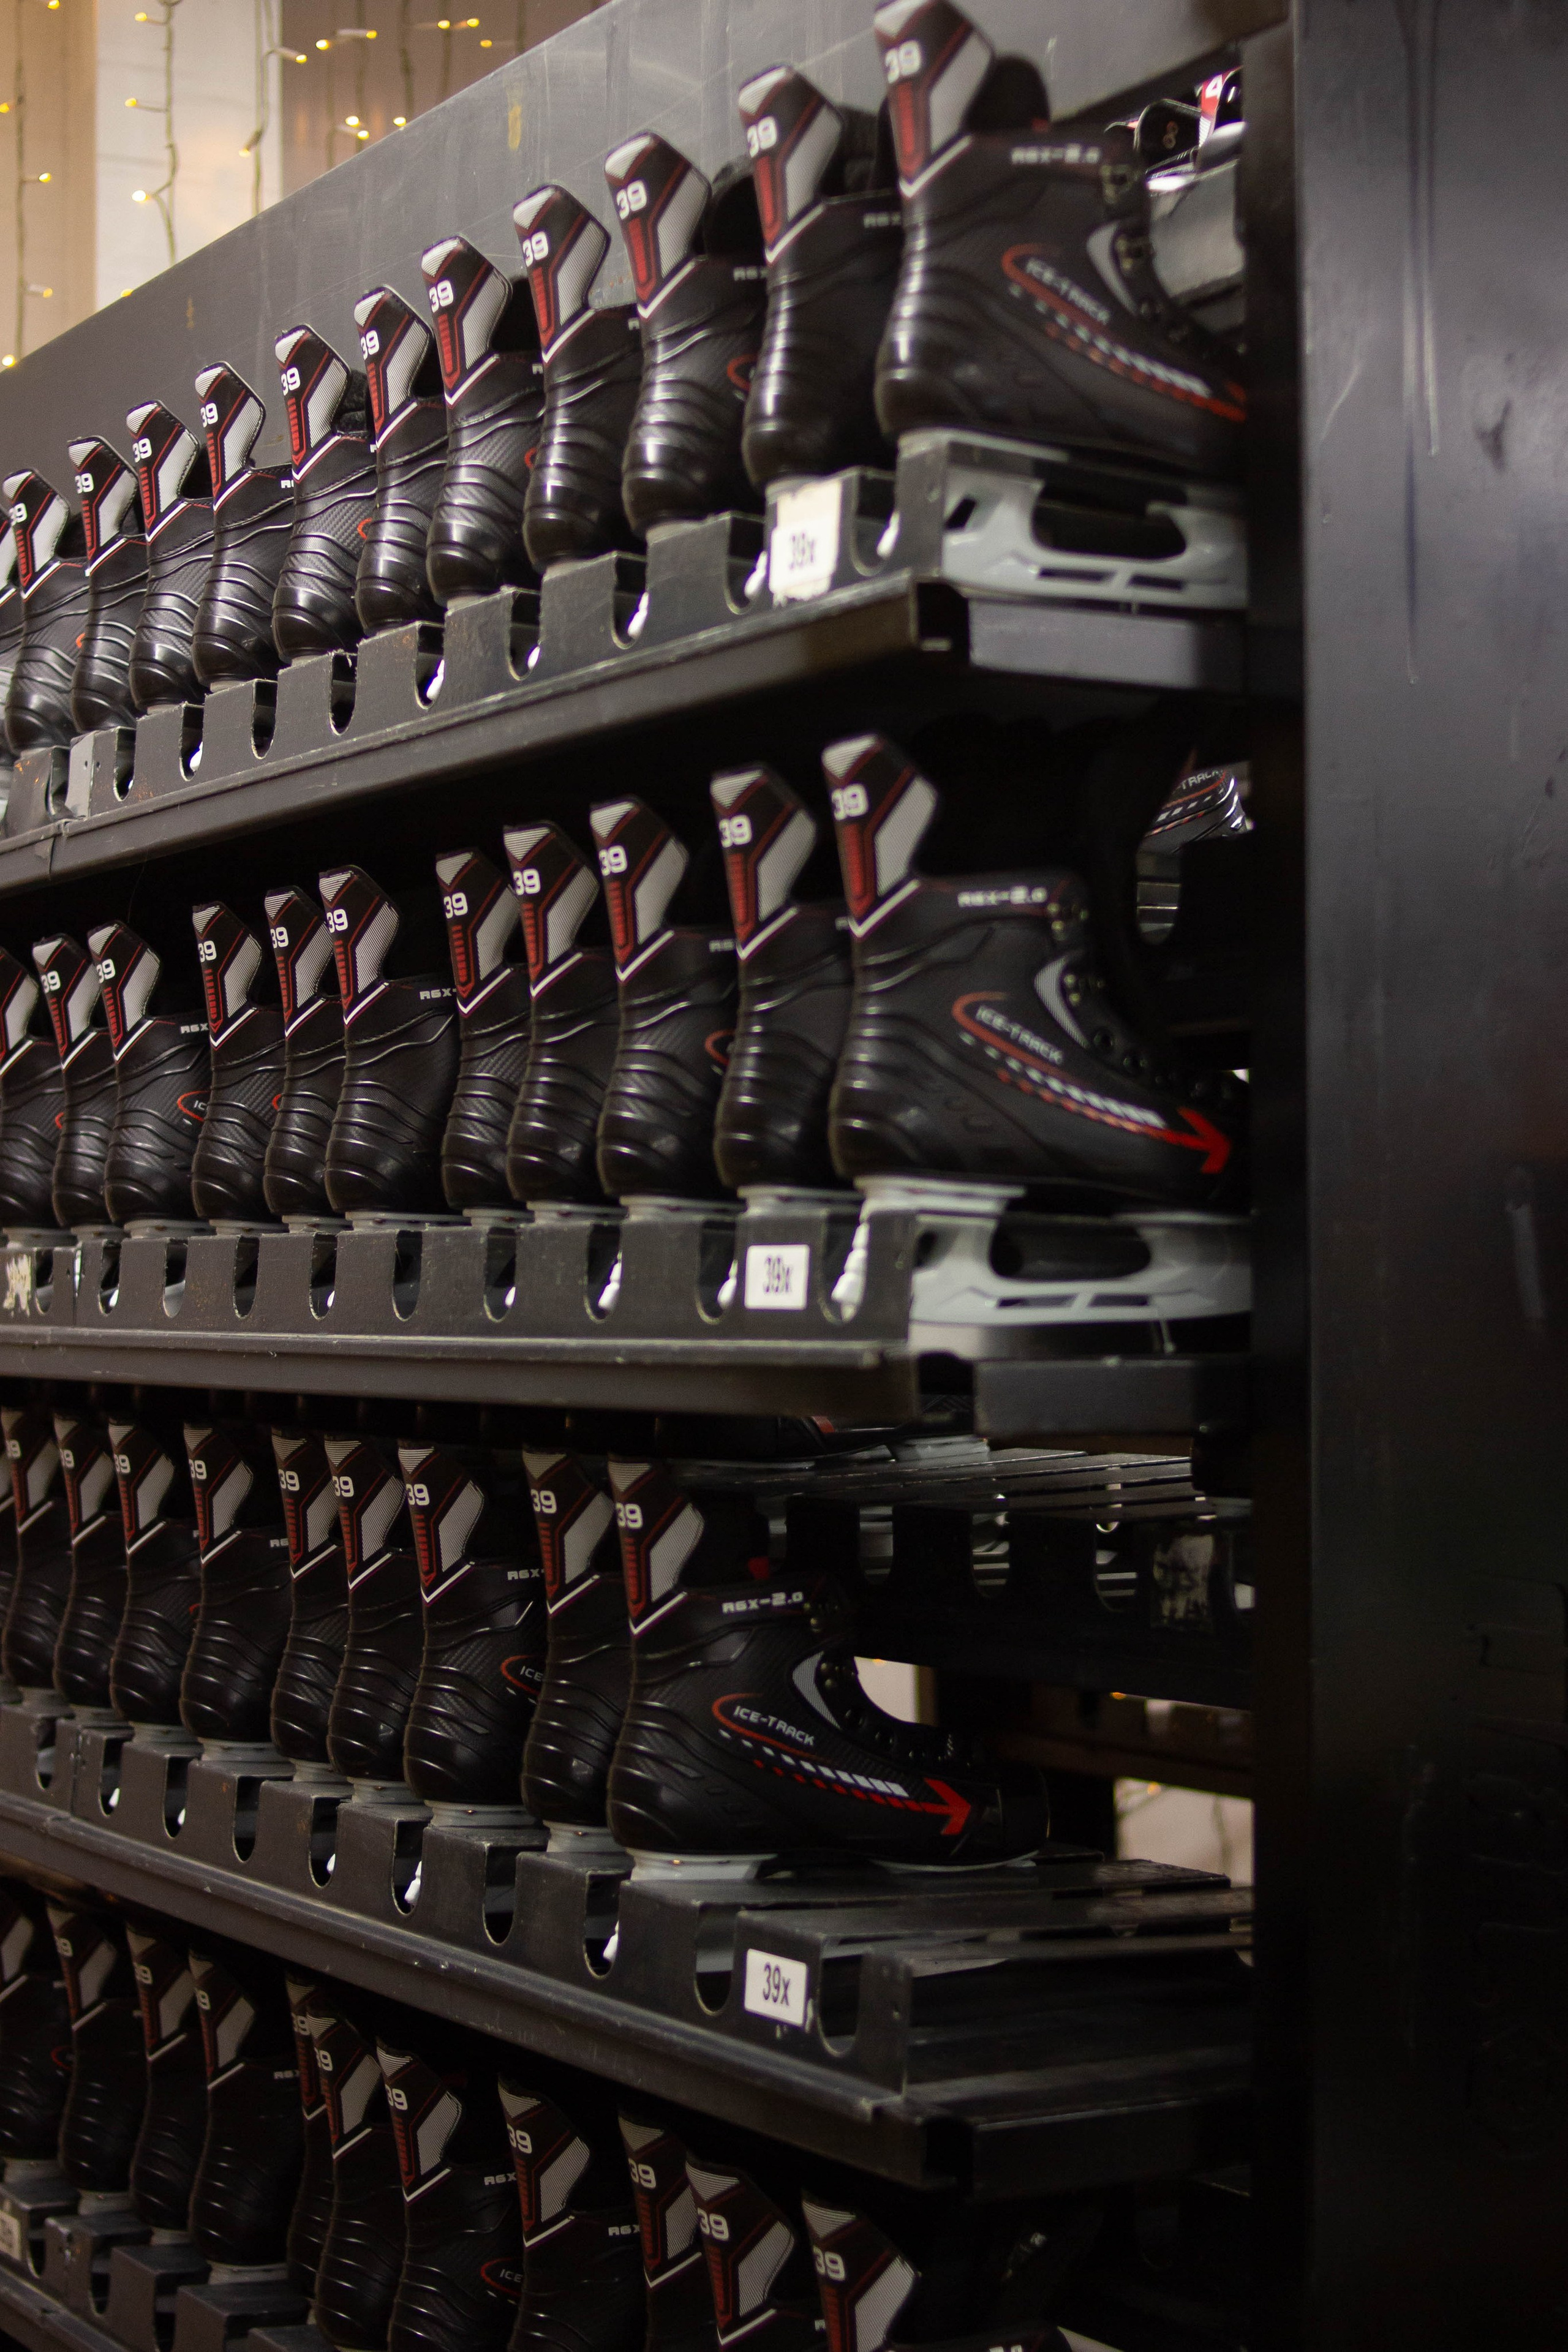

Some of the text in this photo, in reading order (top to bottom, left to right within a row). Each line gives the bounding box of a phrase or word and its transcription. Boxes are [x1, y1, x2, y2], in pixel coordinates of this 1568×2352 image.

[884, 42, 921, 83] 39
[747, 117, 777, 157] 39
[616, 181, 647, 219] 39
[522, 232, 548, 266] 39
[429, 281, 453, 312] 39
[362, 331, 379, 360] 39
[281, 368, 300, 396] 39
[200, 403, 218, 427] 39
[132, 439, 151, 459] 39
[75, 473, 93, 494] 39
[8, 503, 26, 523] 39
[832, 785, 867, 820] 39
[719, 815, 752, 848] 39
[599, 846, 627, 876] 39
[513, 869, 540, 895] 39
[444, 892, 468, 919] 39
[326, 909, 348, 933] 39
[270, 927, 288, 948] 39
[198, 941, 216, 962] 39
[41, 971, 60, 993] 39
[96, 959, 115, 982] 39
[763, 1256, 793, 1294] 39x
[279, 1469, 300, 1491] 39
[333, 1476, 354, 1497] 39
[406, 1484, 429, 1506] 39
[531, 1489, 557, 1513] 39
[616, 1503, 643, 1528] 39
[734, 1706, 815, 1747] ICE-TRACK
[763, 1962, 790, 2007] 39x
[385, 2084, 407, 2110] 39
[507, 2124, 532, 2154] 39
[628, 2158, 656, 2188] 39
[698, 2208, 729, 2241] 39
[813, 2247, 845, 2280] 39
